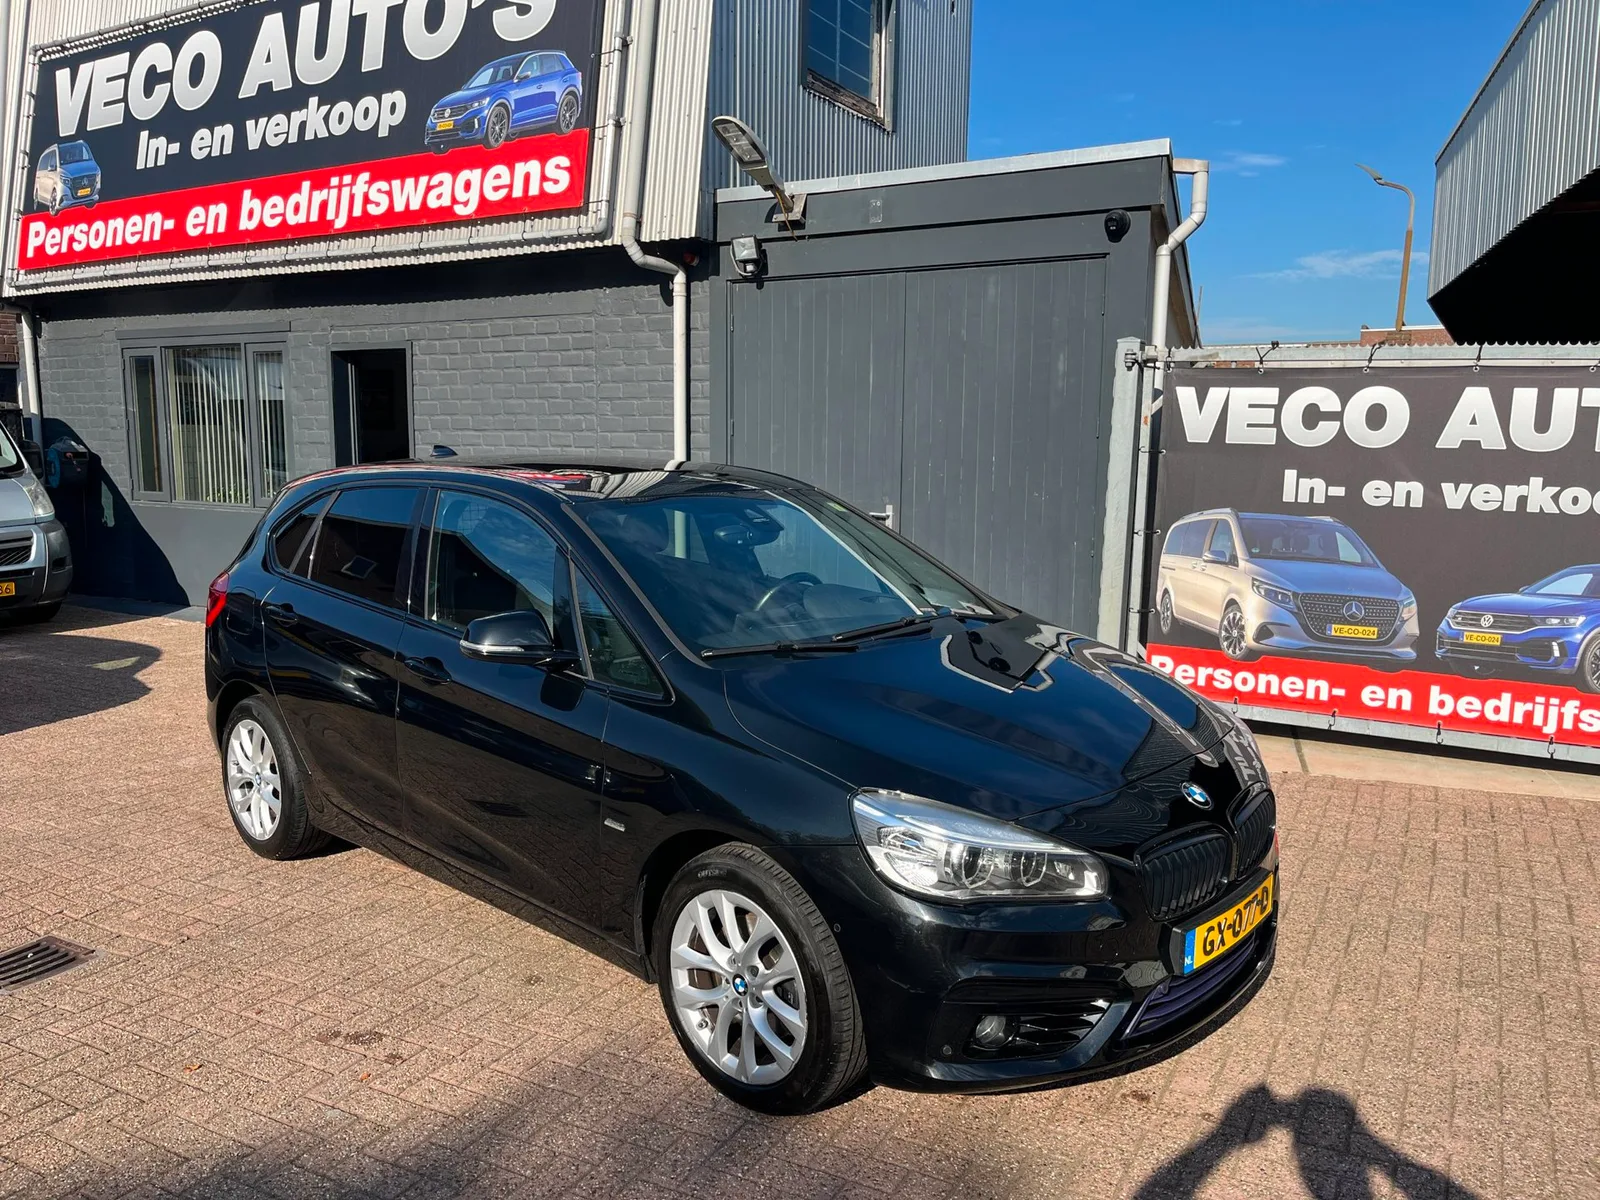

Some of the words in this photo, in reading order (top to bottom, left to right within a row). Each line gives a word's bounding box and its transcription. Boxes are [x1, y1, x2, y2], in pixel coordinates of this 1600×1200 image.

[55, 30, 222, 137] VECO
[238, 0, 555, 99] AUTO
[136, 130, 180, 170] In-
[190, 123, 234, 160] en
[246, 89, 406, 151] verkoop
[26, 202, 174, 258] Personen-
[185, 202, 228, 237] en
[238, 155, 571, 231] bedrijfswagens
[1175, 386, 1410, 448] VECO
[1282, 469, 1346, 503] In-
[1361, 480, 1424, 508] en
[1441, 477, 1600, 514] verko
[1333, 626, 1376, 638] VE-CO-024
[1465, 633, 1500, 644] VE-CO-024
[1151, 655, 1346, 701] Personen-
[1361, 684, 1412, 712] en
[1202, 885, 1269, 956] GX-077-D
